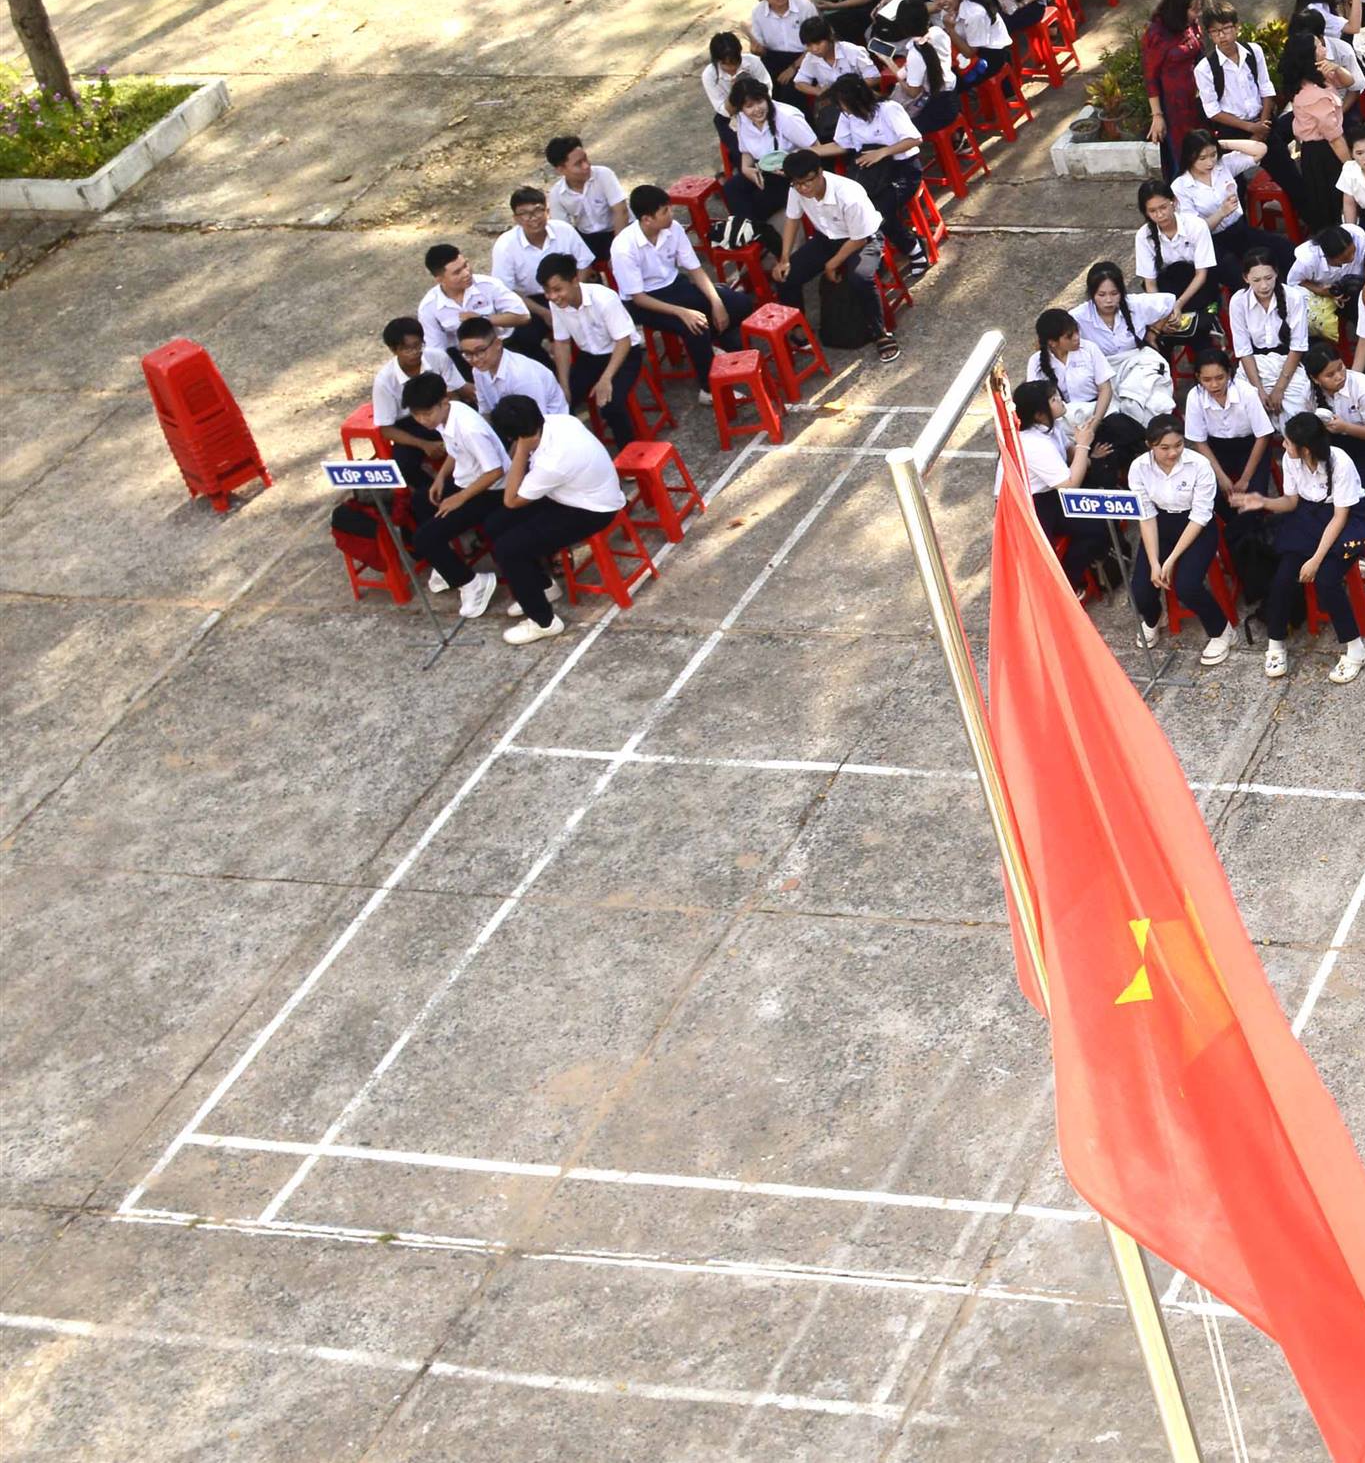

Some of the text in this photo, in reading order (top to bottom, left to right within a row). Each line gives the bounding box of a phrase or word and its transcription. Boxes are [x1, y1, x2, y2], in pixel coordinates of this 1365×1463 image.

[364, 470, 394, 483] 9A5
[1070, 497, 1135, 514] LỚP 9A4
